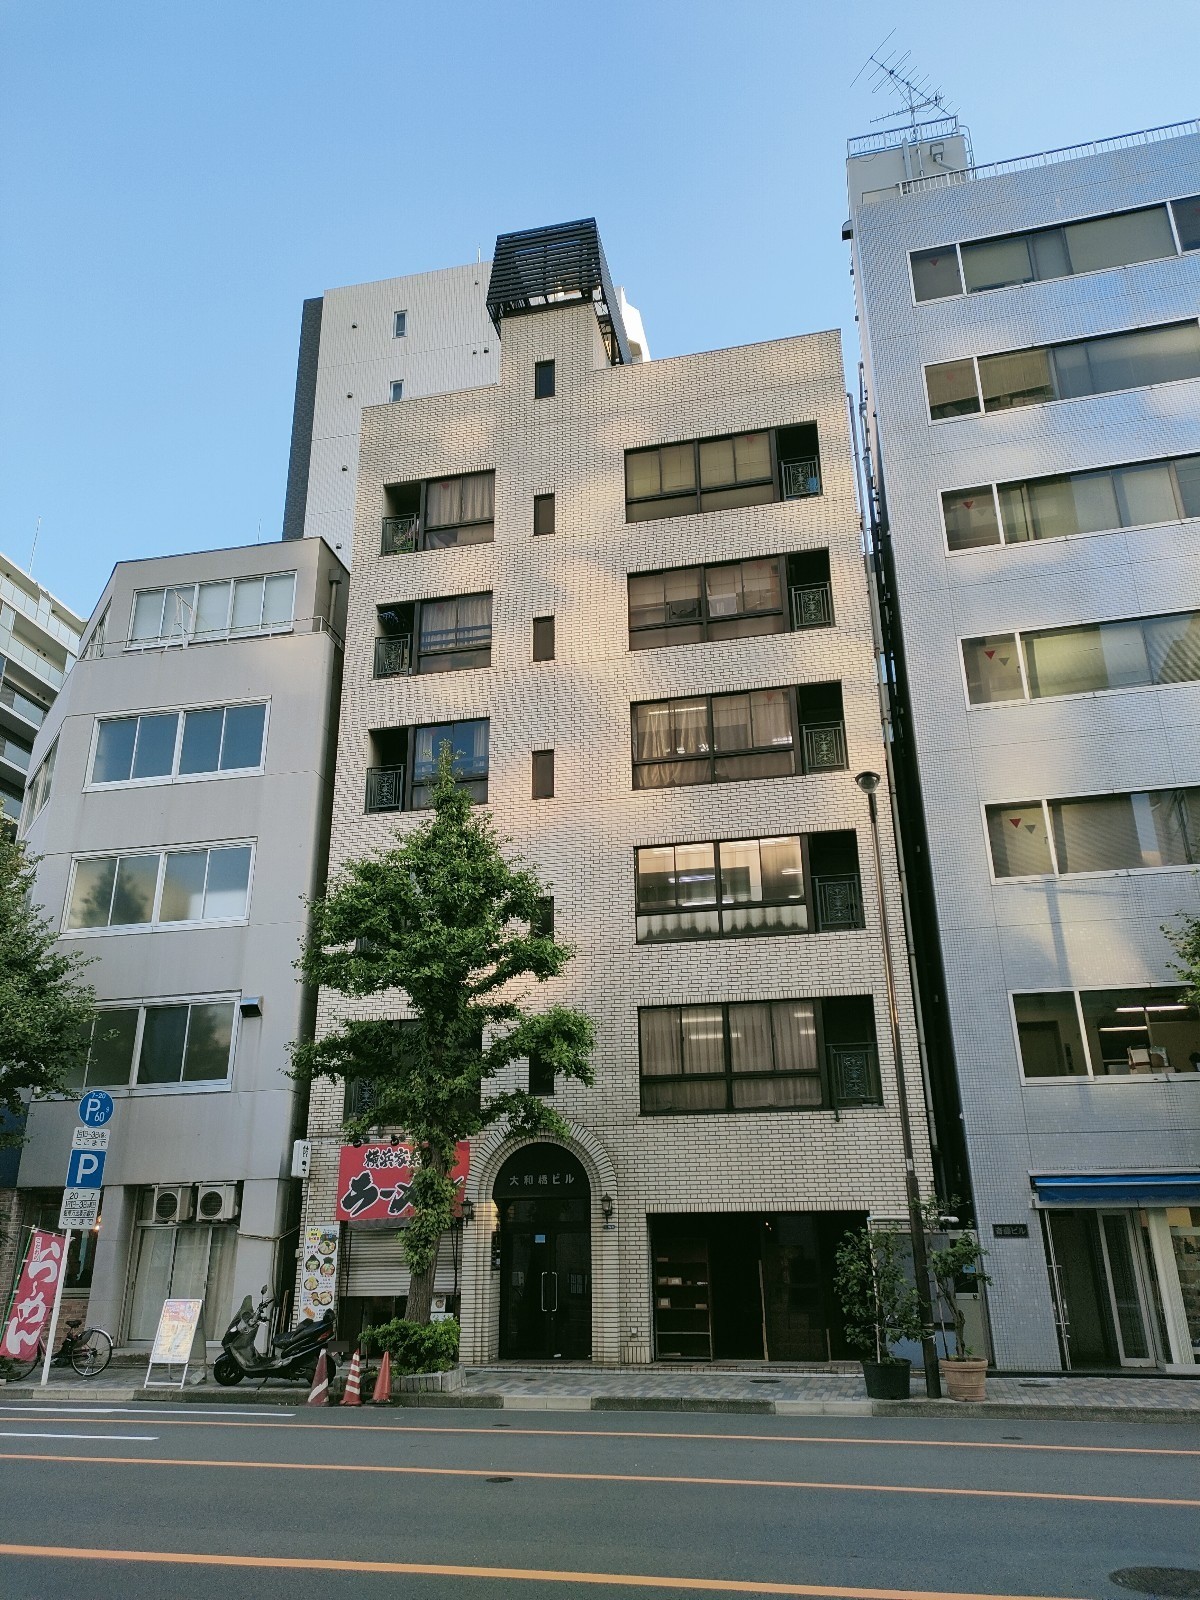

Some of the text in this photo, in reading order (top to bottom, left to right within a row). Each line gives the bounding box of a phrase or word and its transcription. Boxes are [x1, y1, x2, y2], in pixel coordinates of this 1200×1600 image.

[85, 1098, 101, 1121] P
[75, 1138, 107, 1147] ここまで
[75, 1153, 99, 1184] P
[509, 1173, 575, 1186] 大和橋ビル
[62, 1218, 94, 1226] ここまで
